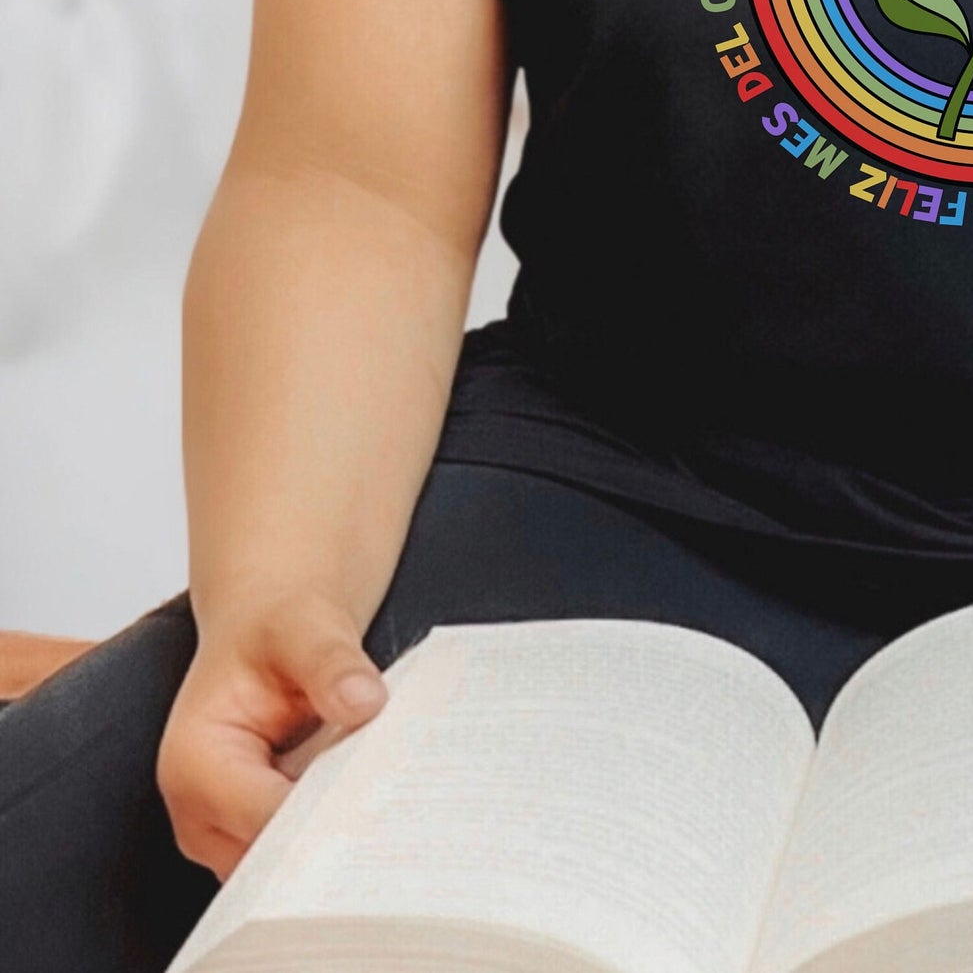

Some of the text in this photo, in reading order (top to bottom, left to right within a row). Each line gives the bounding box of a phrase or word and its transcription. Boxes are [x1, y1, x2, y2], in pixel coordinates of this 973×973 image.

[714, 22, 774, 103] DEL
[761, 102, 849, 180] MES
[849, 162, 968, 227] FELIZ
